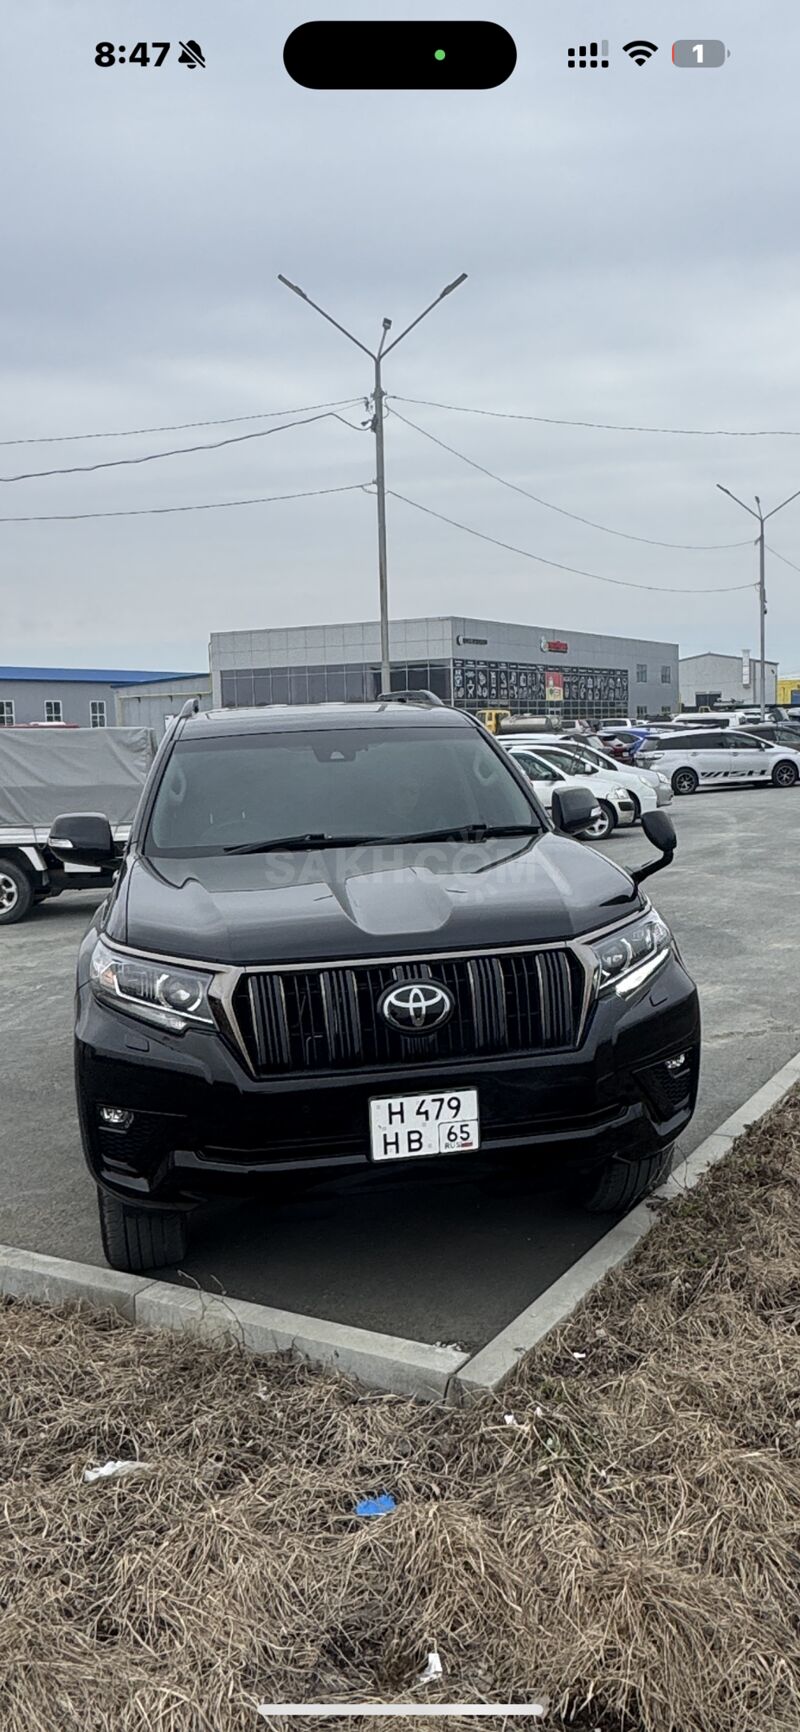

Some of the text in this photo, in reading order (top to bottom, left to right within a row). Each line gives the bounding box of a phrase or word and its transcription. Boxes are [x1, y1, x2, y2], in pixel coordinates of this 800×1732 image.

[416, 1097, 461, 1121] 479
[447, 1124, 470, 1142] 65
[444, 1142, 462, 1150] RUS
